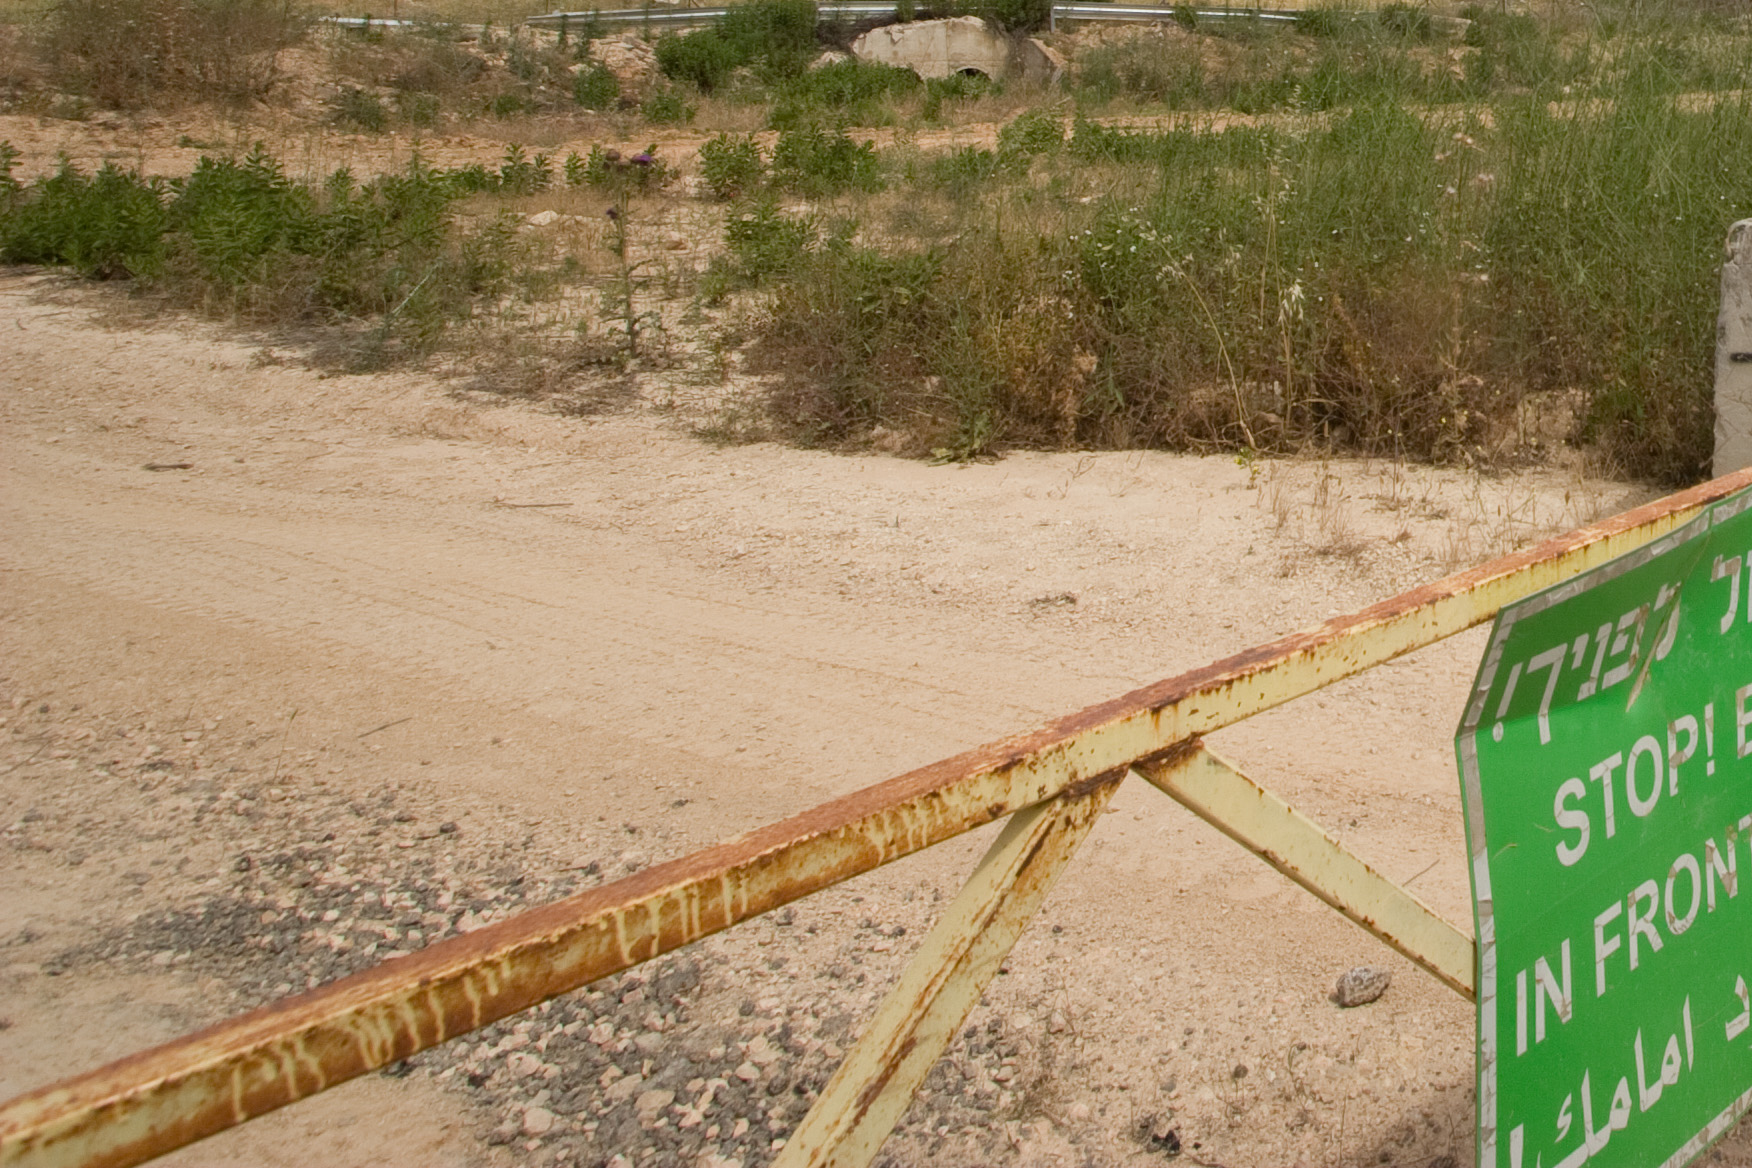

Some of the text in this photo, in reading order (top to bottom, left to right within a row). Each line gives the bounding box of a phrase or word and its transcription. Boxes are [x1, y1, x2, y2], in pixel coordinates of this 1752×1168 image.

[1492, 581, 1682, 745] לפניך!
[1553, 702, 1715, 867] STOP!
[1516, 937, 1572, 1057] IN
